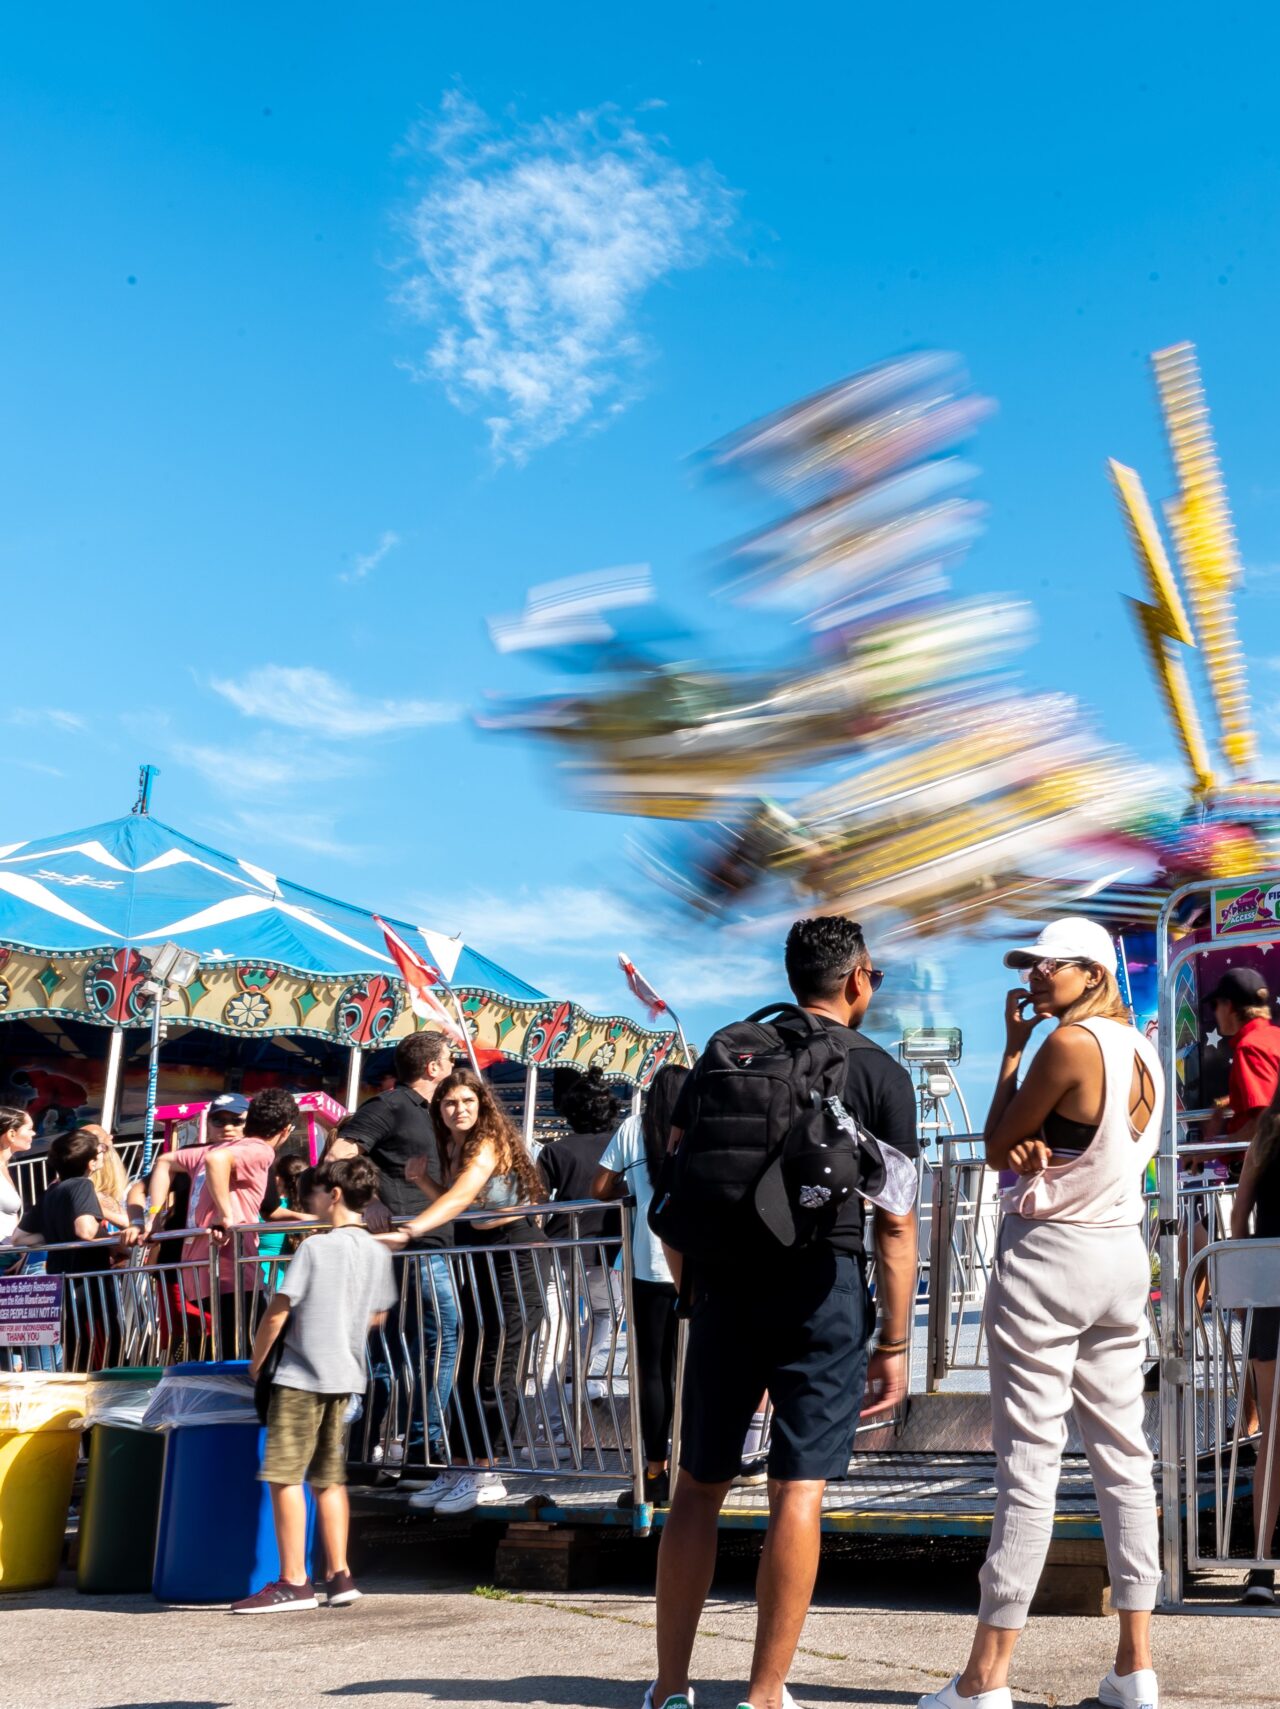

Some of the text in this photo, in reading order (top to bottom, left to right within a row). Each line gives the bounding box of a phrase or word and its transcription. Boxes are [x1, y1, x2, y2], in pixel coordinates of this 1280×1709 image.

[1221, 901, 1257, 921] EXPRESS
[1230, 911, 1256, 924] ACCESS
[18, 1281, 33, 1294] Safety
[33, 1280, 57, 1292] Restraints
[15, 1294, 24, 1305] Ride
[25, 1293, 56, 1305] Manufacturer
[10, 1307, 28, 1318] PEOPLE
[28, 1307, 39, 1318] MAY
[40, 1307, 50, 1318] NOT
[51, 1306, 60, 1318] FIT
[7, 1332, 40, 1341] THANK YOU
